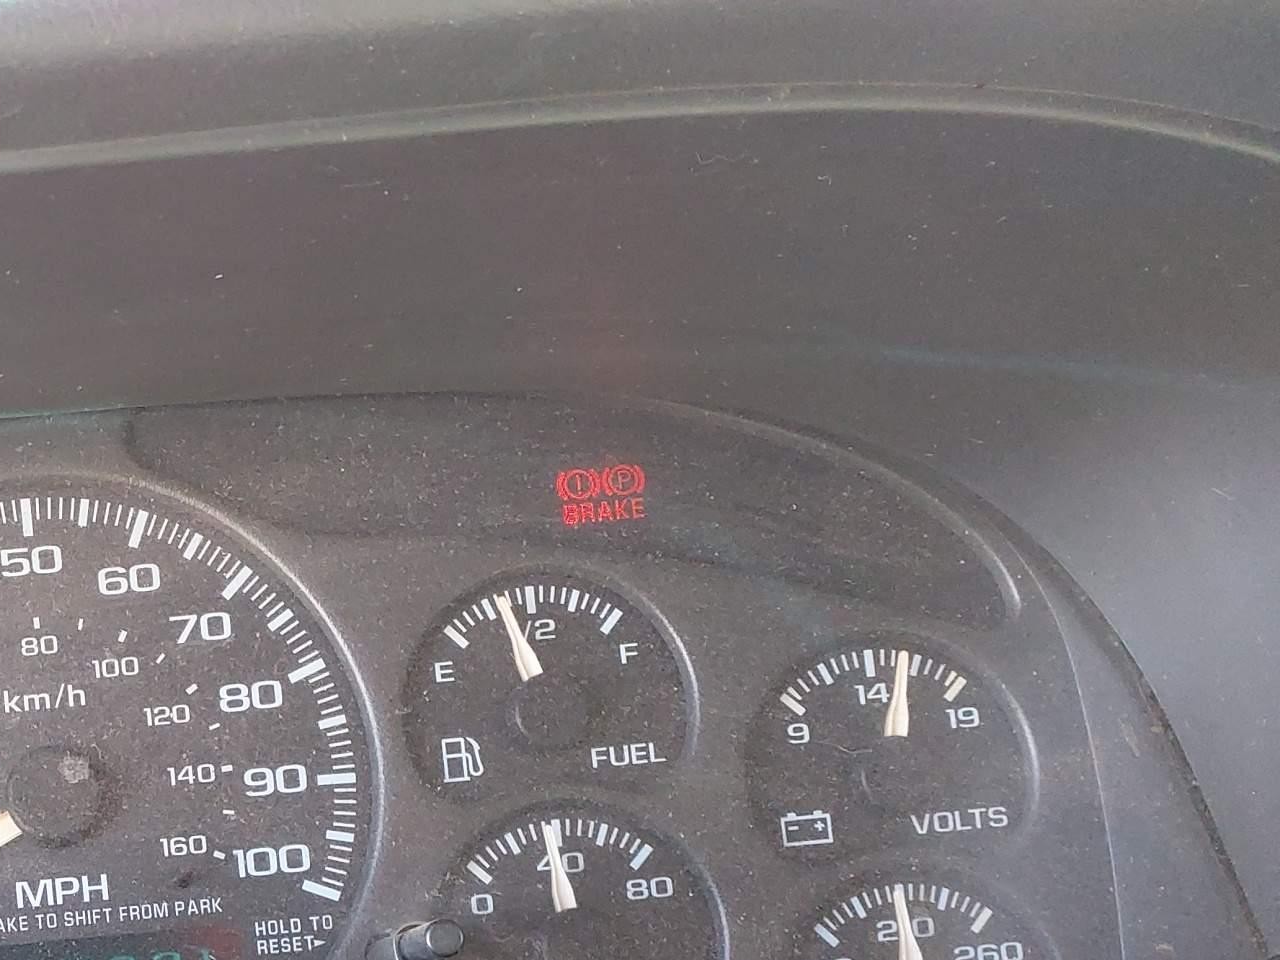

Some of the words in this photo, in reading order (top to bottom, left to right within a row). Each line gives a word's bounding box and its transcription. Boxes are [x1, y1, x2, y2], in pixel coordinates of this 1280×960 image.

[563, 497, 647, 525] BRAKE
[0, 545, 63, 578] 50
[98, 564, 161, 594] 60
[169, 612, 232, 644] 70
[20, 636, 59, 656] 80
[620, 643, 639, 664] F
[92, 657, 140, 678] 100
[434, 661, 455, 683] E
[3, 686, 86, 713] km/h
[219, 680, 283, 711] 80
[854, 682, 890, 705] 14
[144, 705, 191, 726] 120
[944, 706, 980, 729] 19
[787, 723, 810, 744] 9
[590, 742, 667, 768] FUEL
[167, 764, 216, 785] 140
[243, 764, 308, 796] 90
[910, 806, 1009, 834] VOLTS
[160, 836, 207, 857] 160
[233, 844, 311, 878] 100
[15, 874, 109, 909] MPH
[626, 876, 674, 900] 80
[35, 913, 57, 929] TO
[63, 907, 112, 927] SHIFT
[120, 902, 170, 922] FROM
[175, 897, 223, 916] PARK
[471, 894, 494, 915] 0
[254, 918, 302, 937] HOLD
[308, 914, 334, 931] TO
[876, 917, 936, 942] 20
[257, 935, 314, 955] RESET
